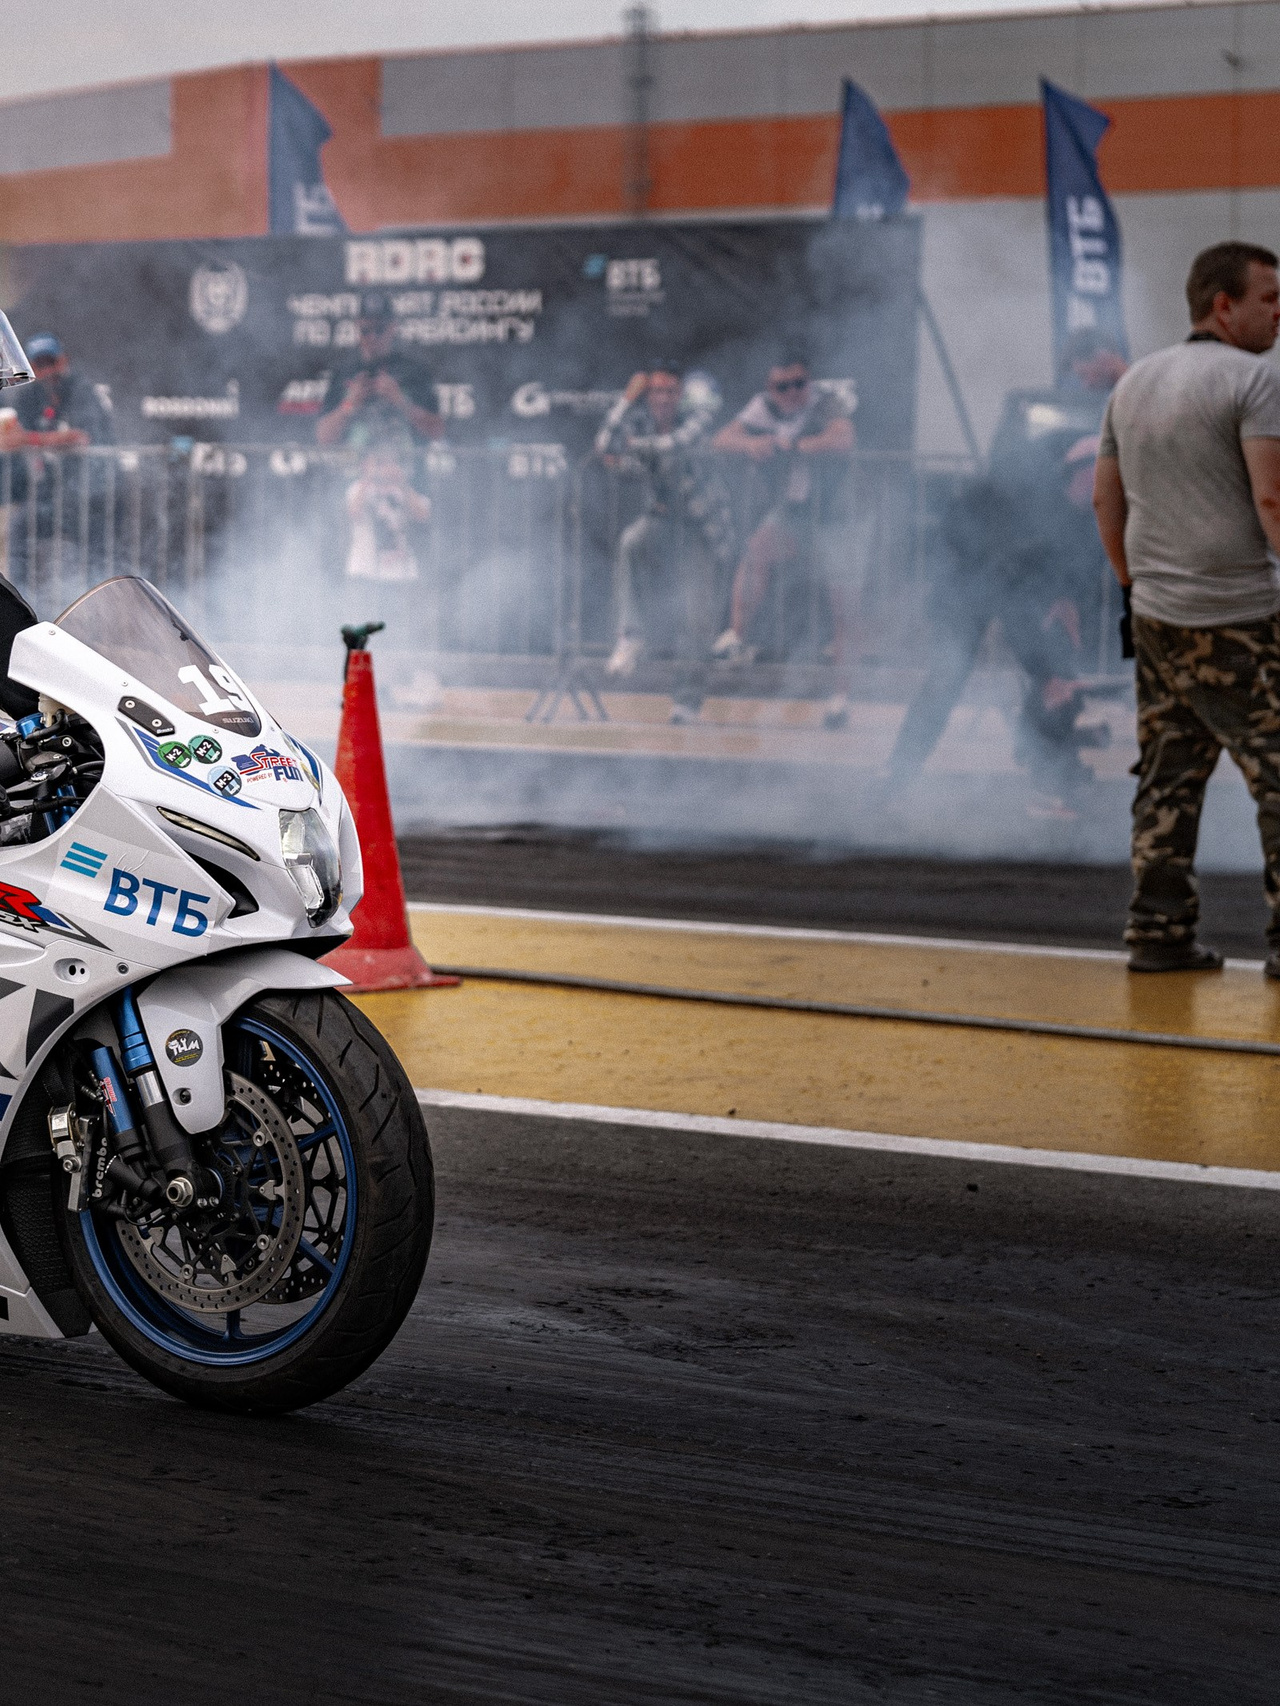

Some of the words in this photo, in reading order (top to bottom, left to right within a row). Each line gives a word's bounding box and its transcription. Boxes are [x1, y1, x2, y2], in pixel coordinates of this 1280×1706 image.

[1066, 195, 1110, 294] ВТБ
[177, 664, 254, 716] 19
[103, 867, 211, 937] ВТБ
[92, 1137, 108, 1198] brembo
